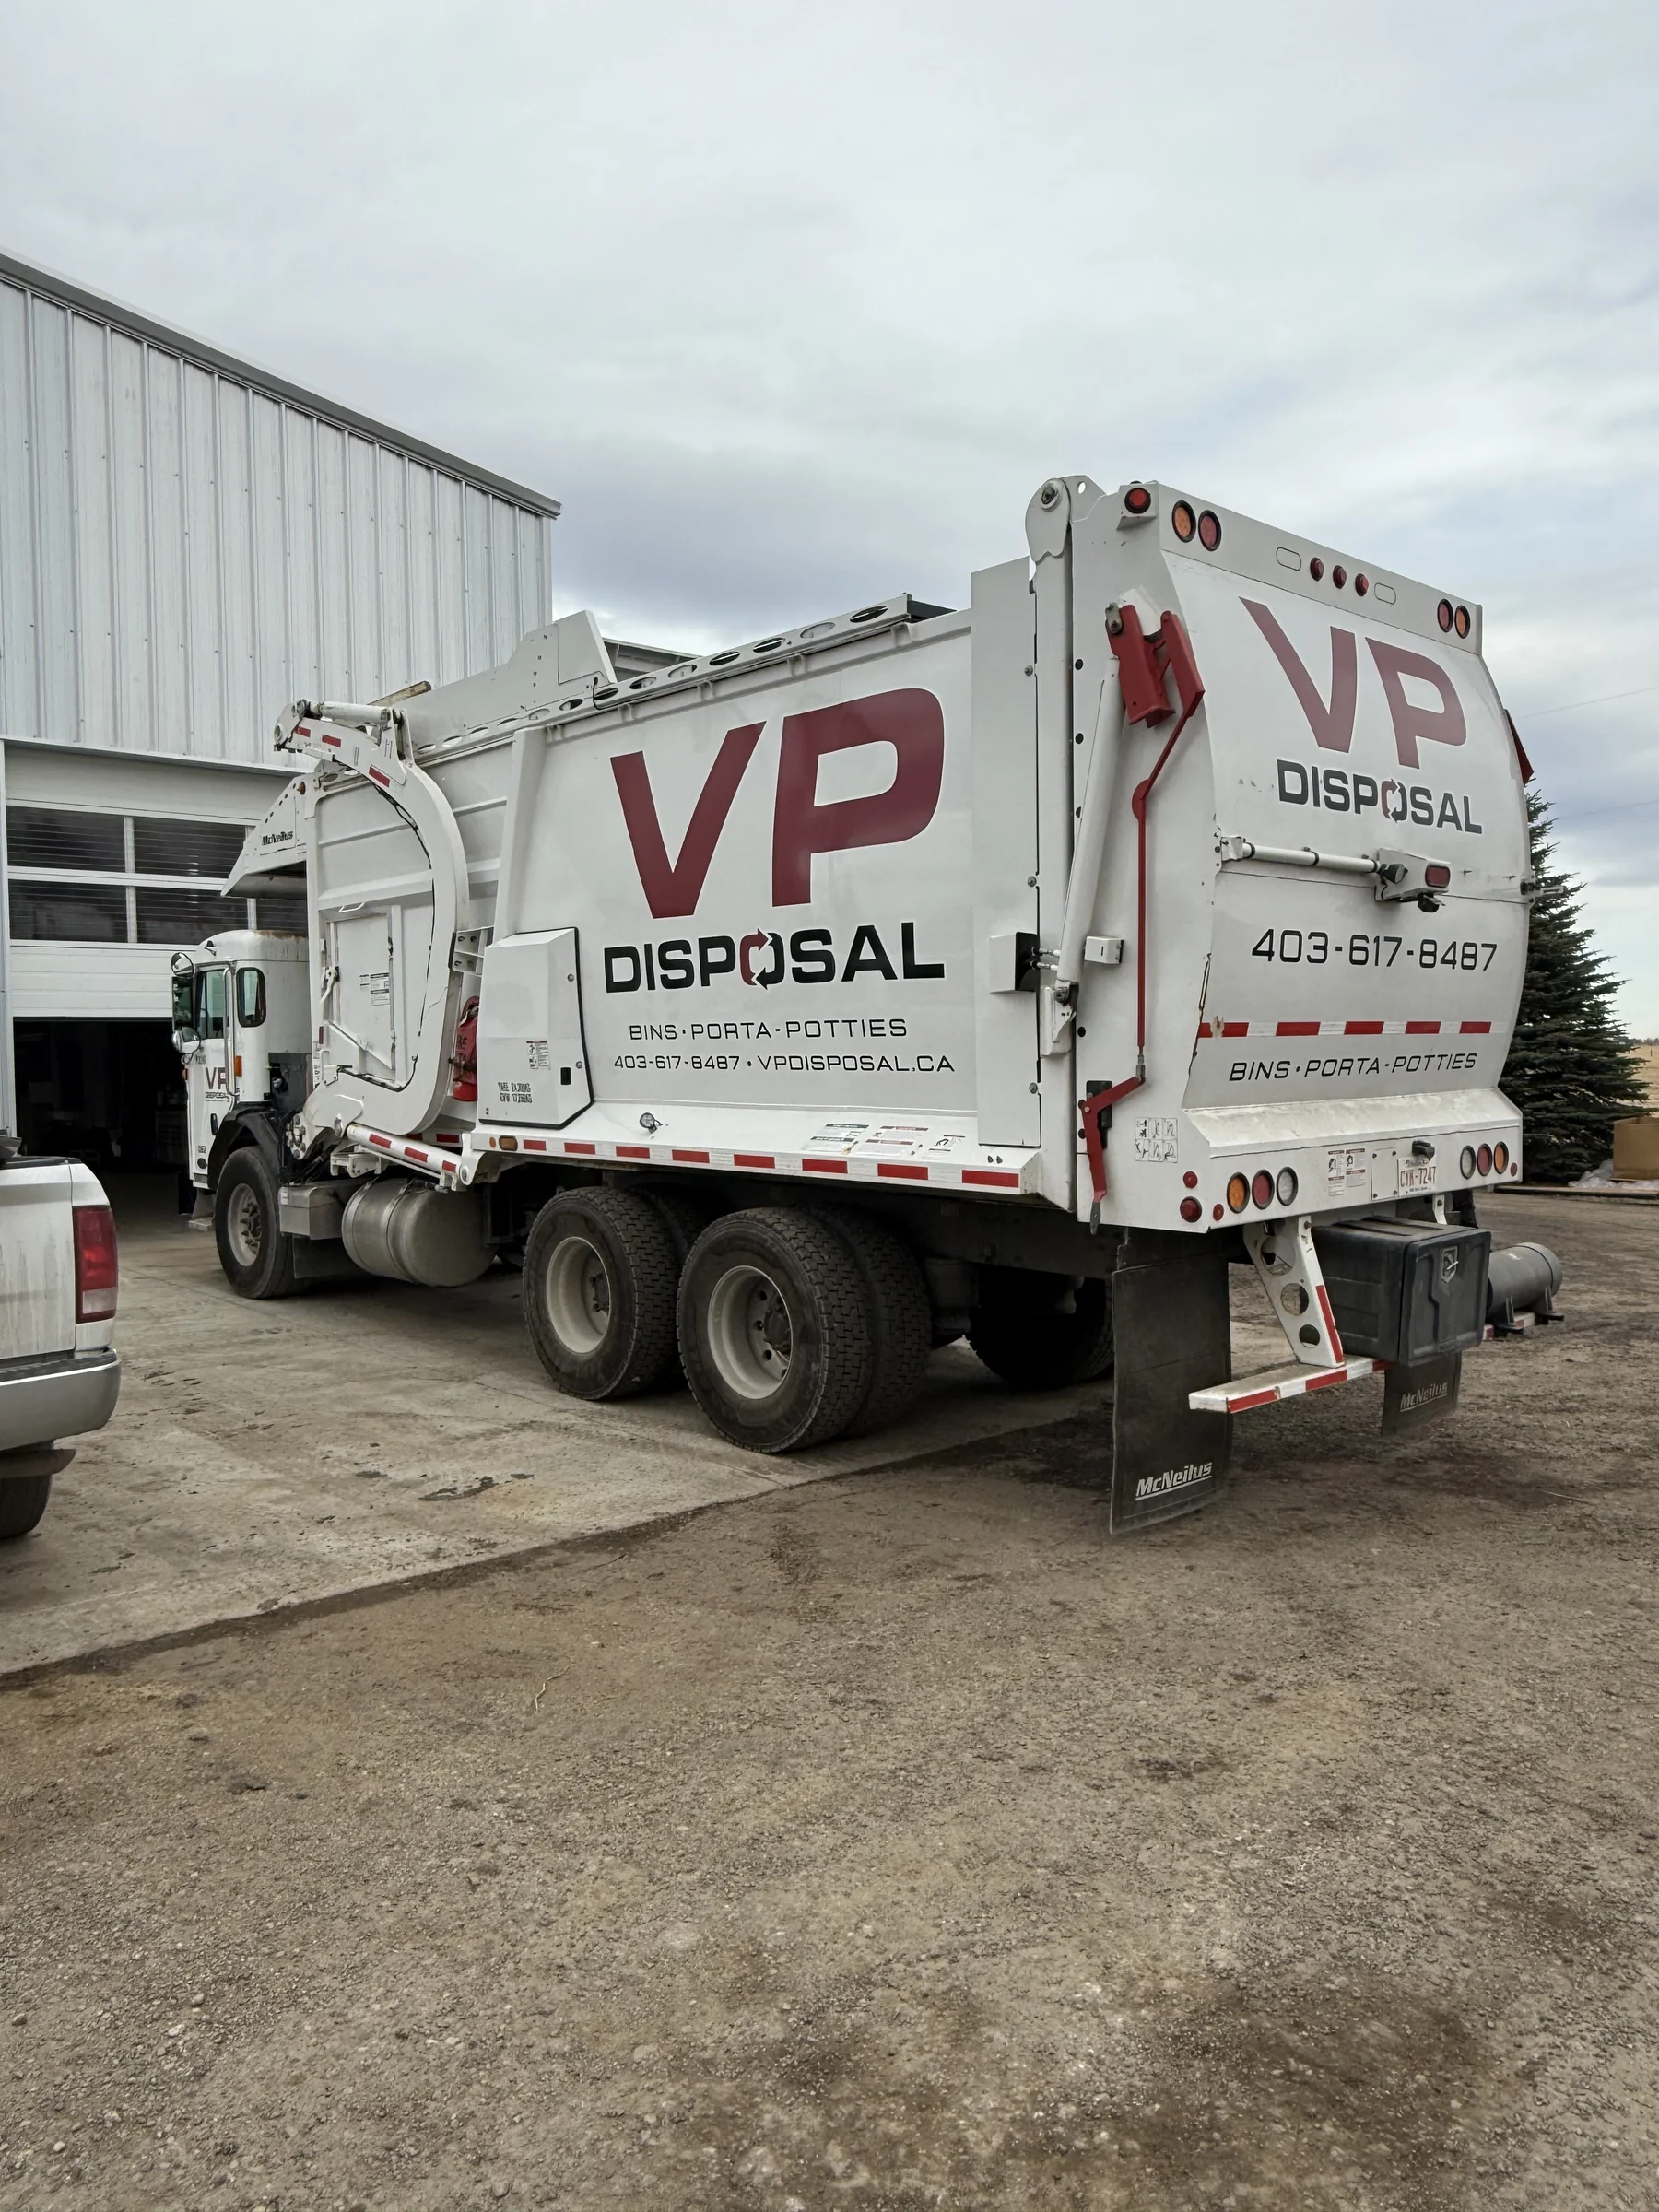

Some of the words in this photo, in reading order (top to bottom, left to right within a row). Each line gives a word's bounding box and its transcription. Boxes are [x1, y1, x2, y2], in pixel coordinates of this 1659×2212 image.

[1238, 595, 1467, 770] VP
[609, 688, 945, 920] VP
[1277, 759, 1483, 836] DISPOSAL
[604, 921, 946, 994] DISPOSAL
[1251, 928, 1498, 971] 403-617-8487
[613, 1054, 740, 1070] 403-617-8487
[1400, 1382, 1448, 1410] McNeilus
[1135, 1462, 1213, 1498] McNeilus
